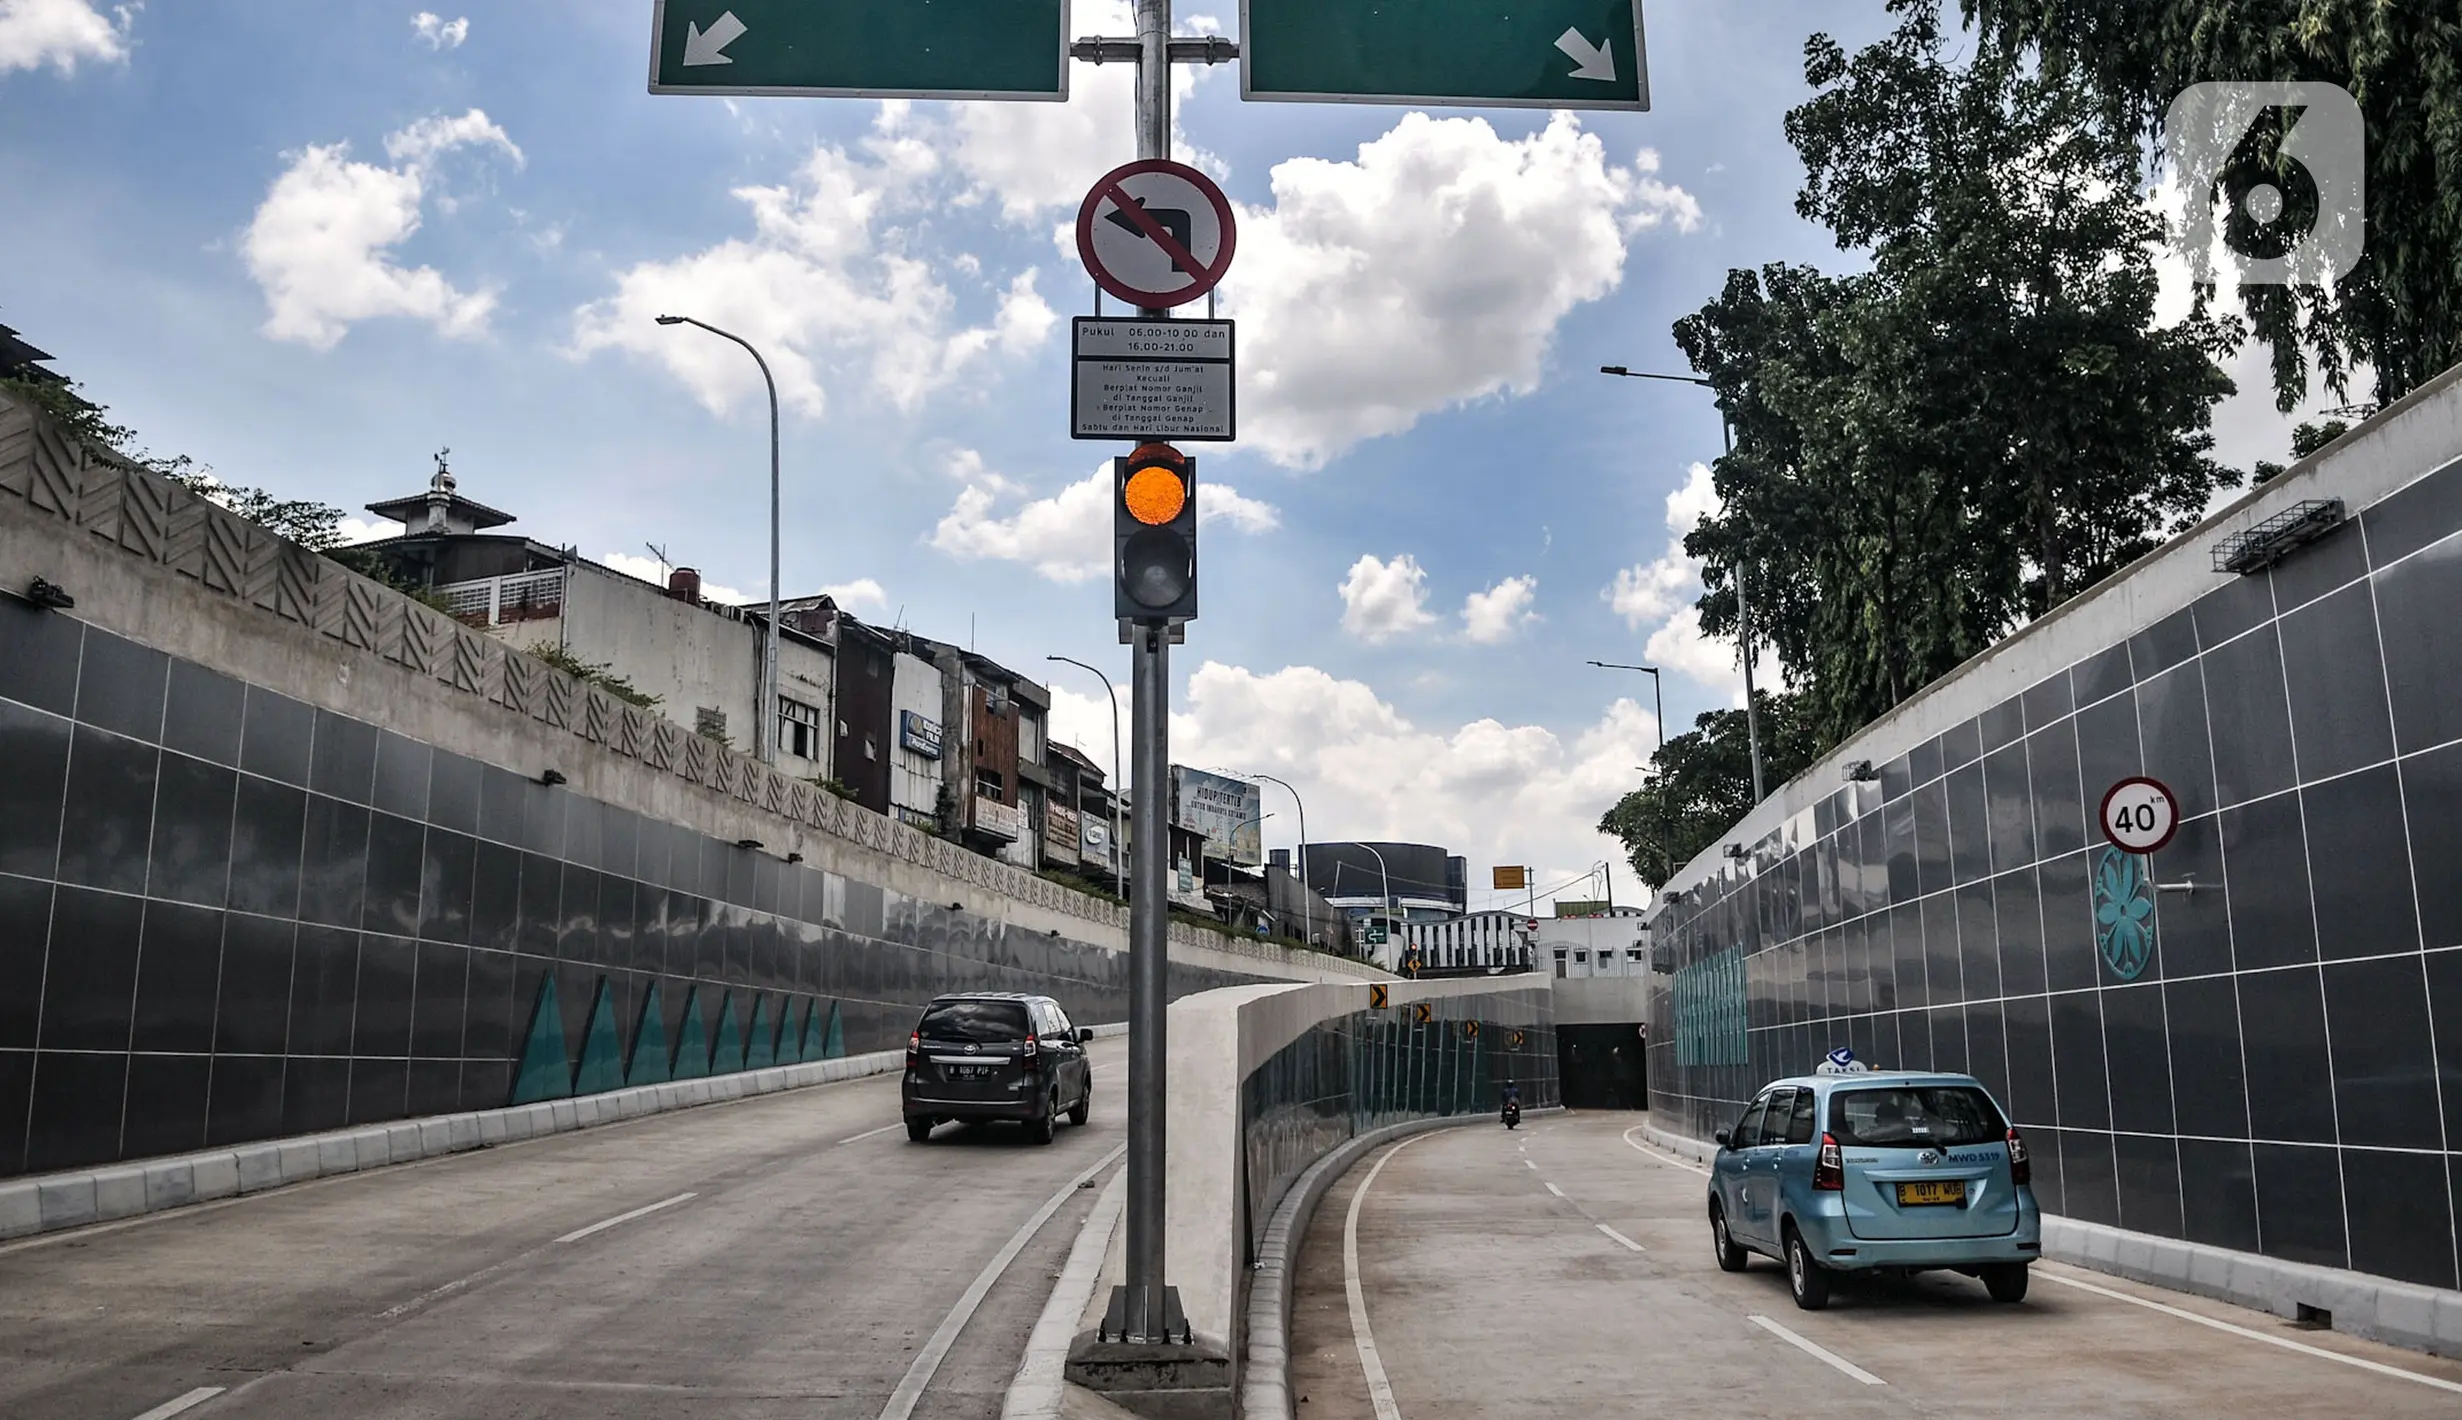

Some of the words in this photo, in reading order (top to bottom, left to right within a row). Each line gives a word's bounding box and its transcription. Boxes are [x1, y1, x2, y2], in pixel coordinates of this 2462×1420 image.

[1082, 326, 1114, 336] Pukul
[1204, 329, 1225, 338] dan
[1128, 342, 1194, 352] 16.00-21.00
[1174, 365, 1203, 373] Jum'at
[1104, 384, 1137, 392] Berplat
[1176, 385, 1202, 394] Ganjil
[1113, 393, 1121, 401] di
[1126, 394, 1162, 403] Tanggal
[1166, 395, 1193, 404] Ganjil
[1103, 404, 1136, 412] Berplat
[1175, 405, 1203, 413] Genap
[1125, 414, 1161, 423] Tanggal
[1165, 415, 1194, 423] Genap
[1082, 423, 1108, 431] Sabtu
[1156, 424, 1180, 432] Libur
[1183, 425, 1224, 433] Nasional
[1196, 785, 1218, 802] HIDUP
[1219, 790, 1242, 808] TERTIB
[2115, 803, 2155, 833] 40
[2150, 795, 2165, 804] km
[1948, 1153, 1977, 1163] MWD
[1899, 1184, 1906, 1197] B
[1914, 1183, 1937, 1197] 1017
